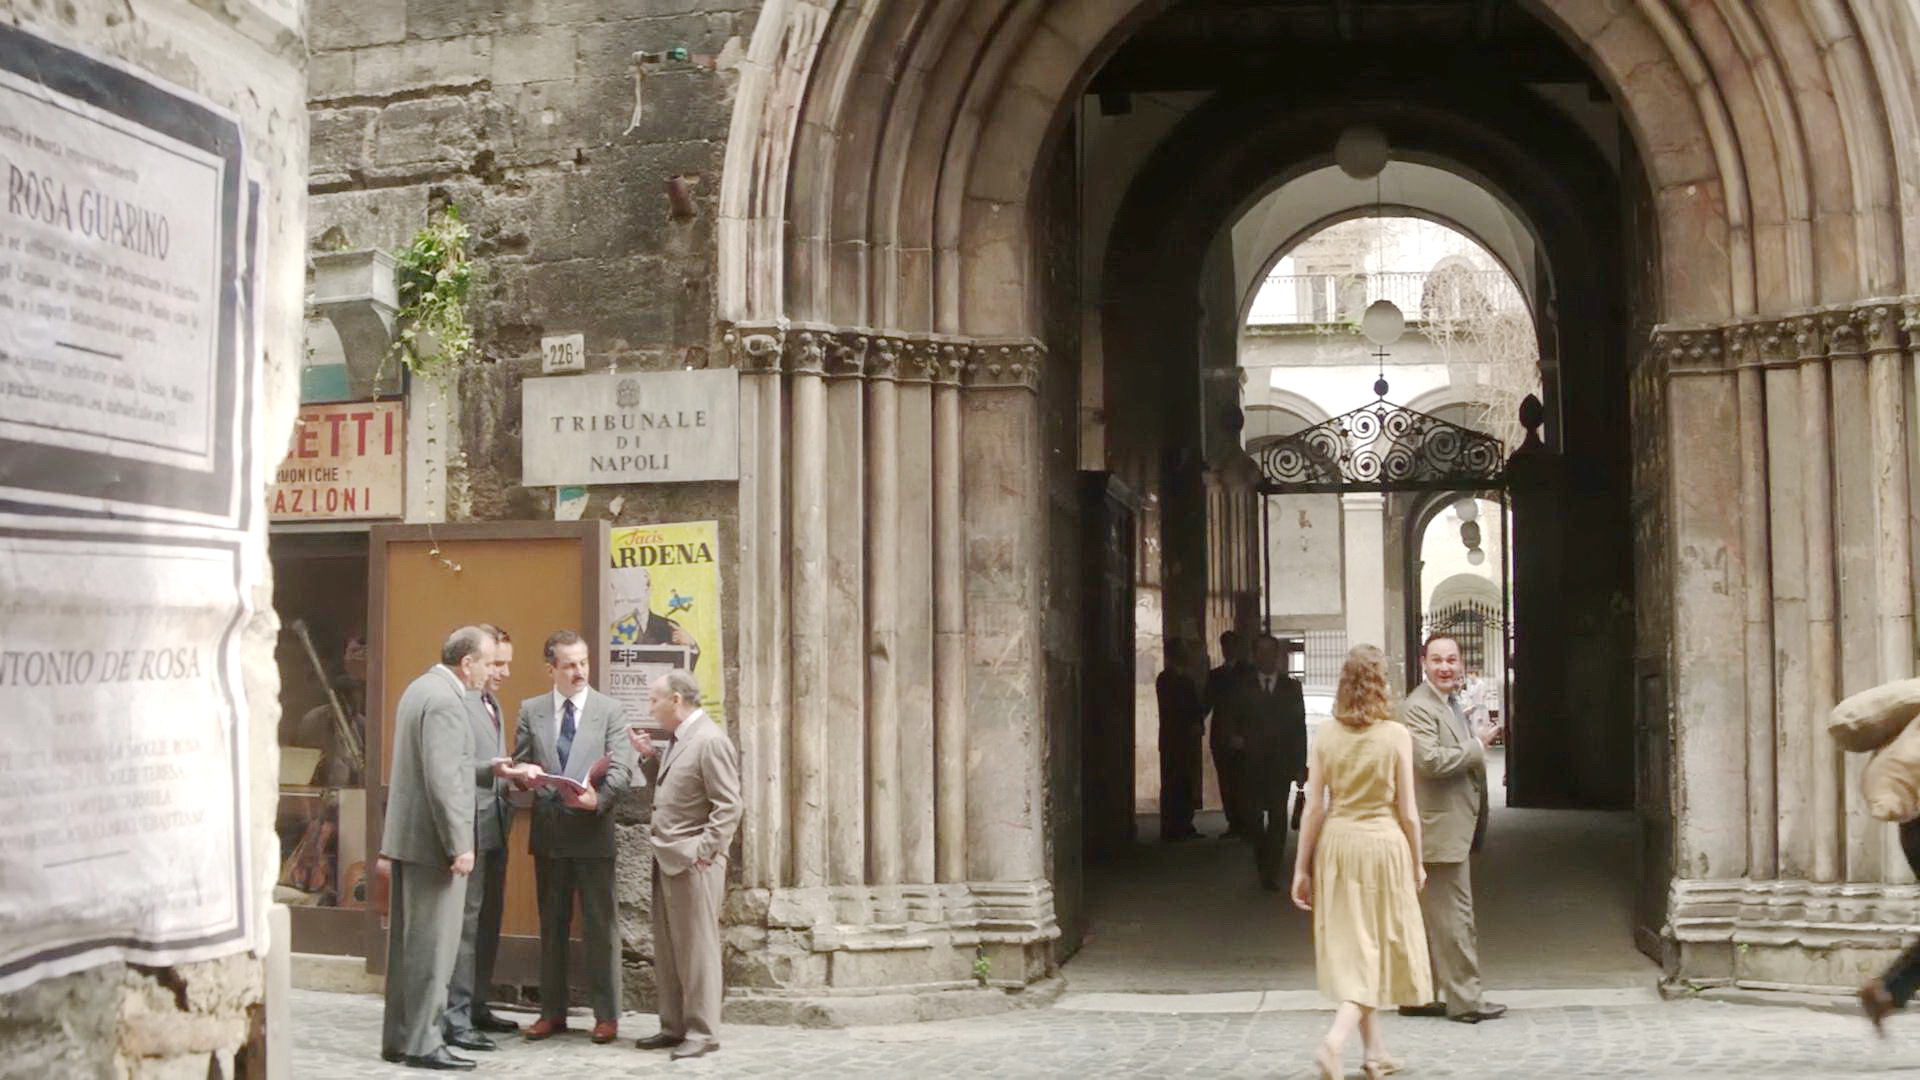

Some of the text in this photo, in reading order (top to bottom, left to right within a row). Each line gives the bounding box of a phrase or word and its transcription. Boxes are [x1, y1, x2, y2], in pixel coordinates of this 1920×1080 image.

[9, 164, 72, 231] ROSA
[79, 189, 170, 261] GUARINO
[550, 343, 573, 366] 226
[551, 411, 706, 432] TRIBUNALE
[286, 412, 393, 459] ETTI
[617, 436, 640, 449] DI
[590, 454, 670, 472] NAPOLI
[98, 650, 134, 683] DE
[138, 646, 201, 681] ROSA
